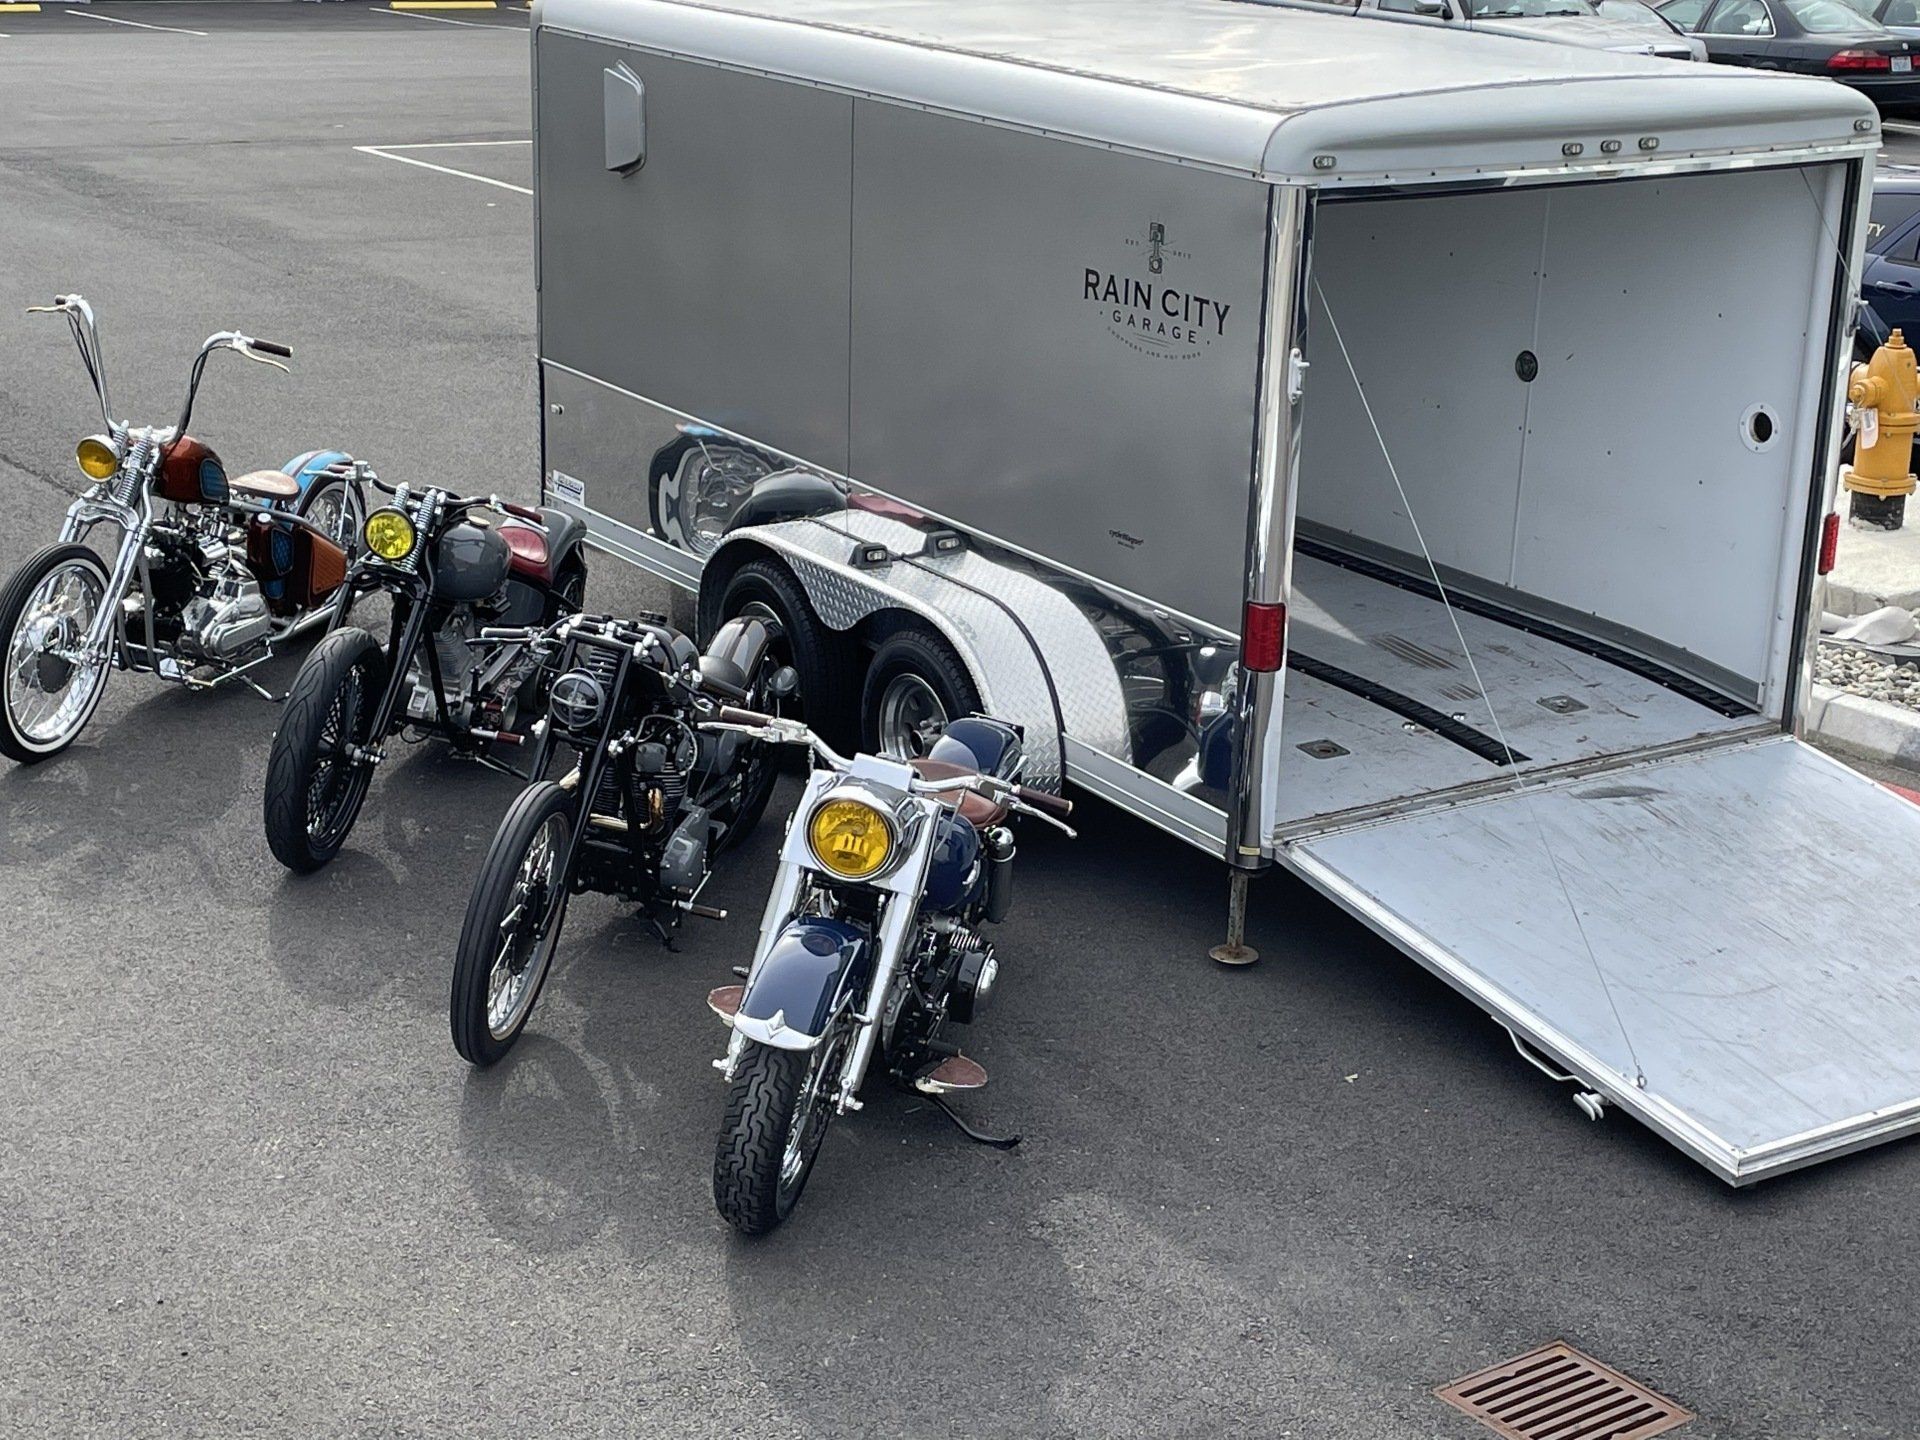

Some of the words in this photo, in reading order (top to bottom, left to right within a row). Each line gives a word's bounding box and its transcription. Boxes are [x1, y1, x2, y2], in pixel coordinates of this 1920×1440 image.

[1083, 268, 1152, 311] RAIN
[1161, 289, 1231, 336] CITY
[1112, 309, 1197, 344] GARAGE
